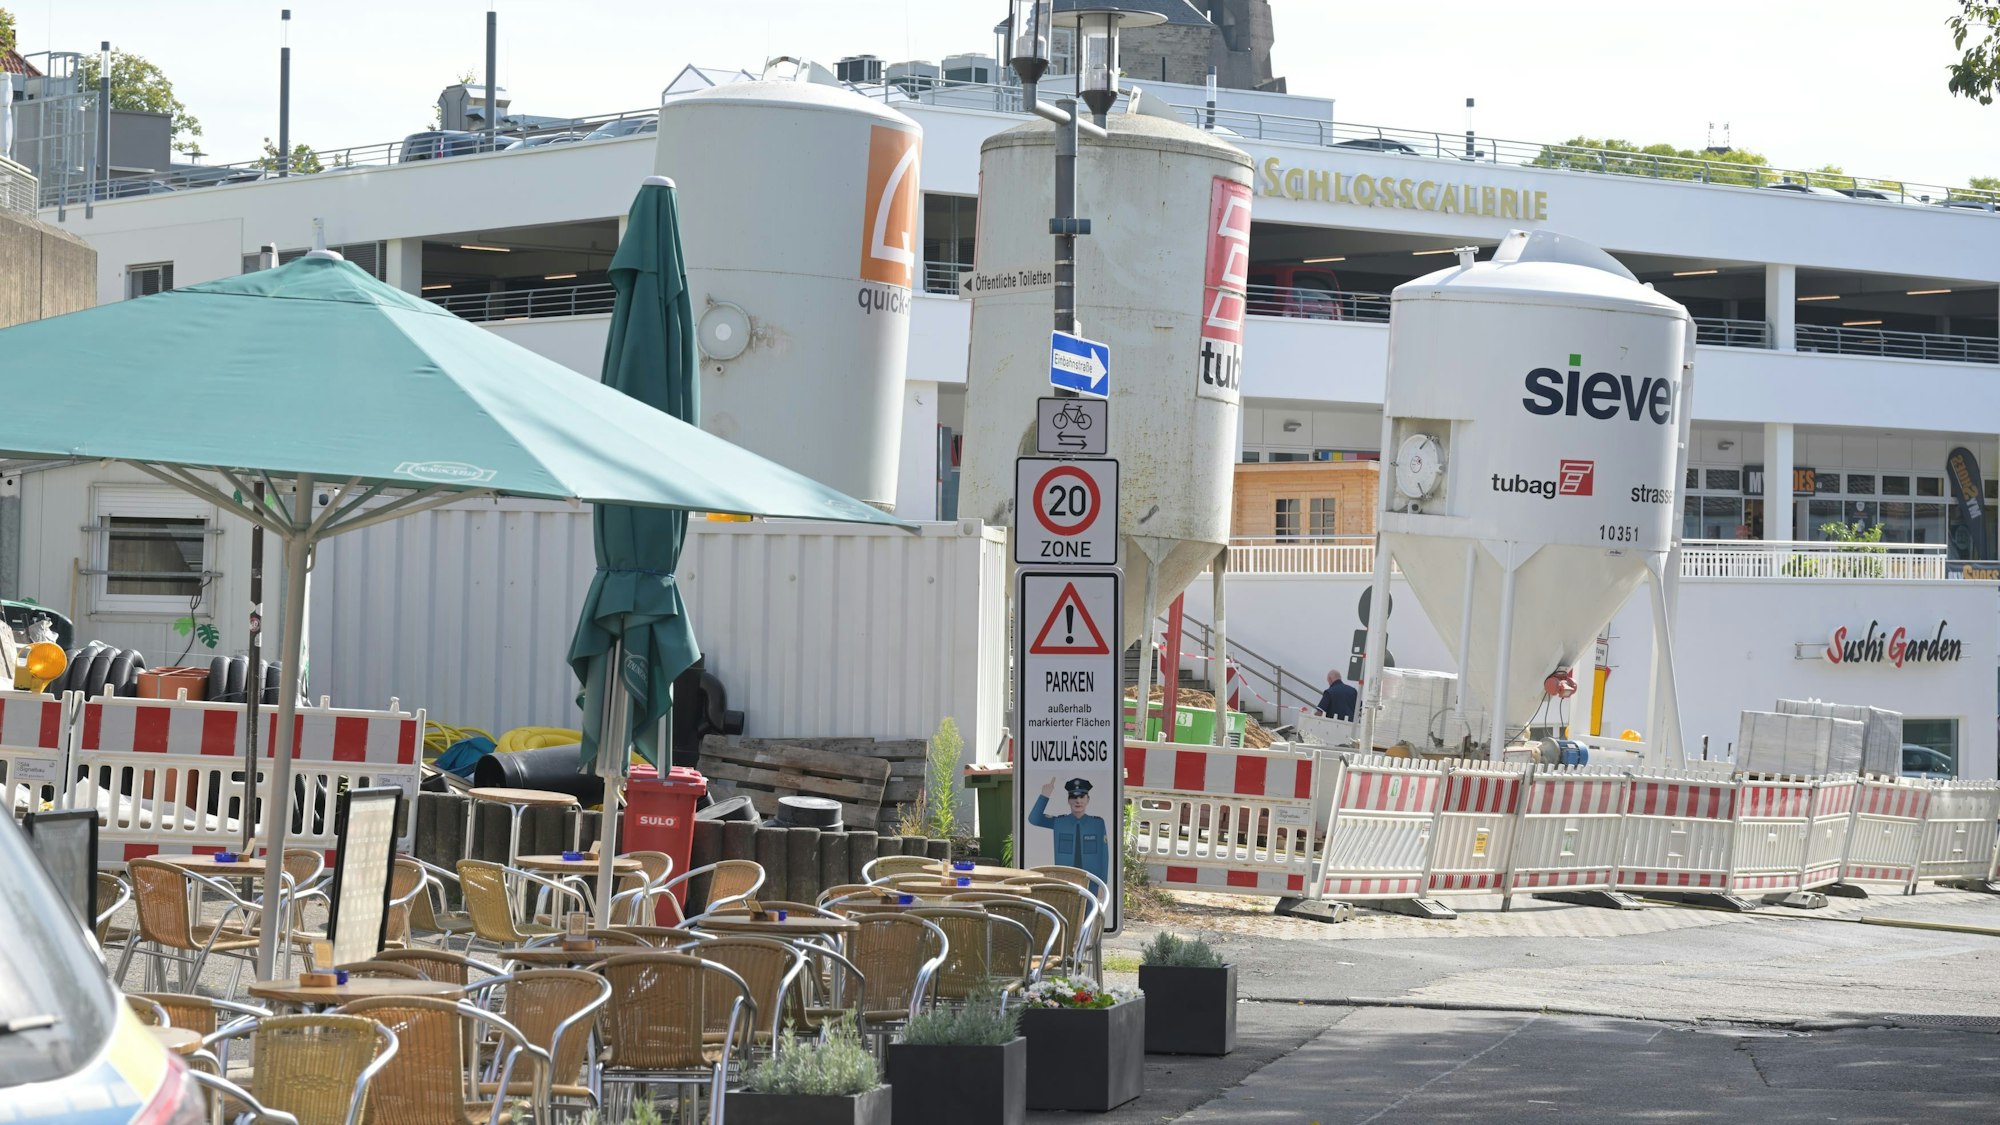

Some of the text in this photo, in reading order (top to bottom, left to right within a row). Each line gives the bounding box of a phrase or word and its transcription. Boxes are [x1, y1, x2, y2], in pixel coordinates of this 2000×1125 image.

[1263, 156, 1548, 221] SCHLOSSGALERIE
[976, 270, 1052, 291] Öffentliche Toiletten
[1054, 353, 1093, 374] Einbahnstraße
[1492, 473, 1557, 499] tubag
[1048, 484, 1086, 517] 20
[1600, 525, 1639, 542] 10351
[1040, 540, 1092, 558] ZONE
[1826, 619, 1962, 669] Sushi Garden
[1045, 671, 1094, 692] PARKEN
[1047, 703, 1092, 713] außerhalb
[1028, 717, 1111, 727] markierter Flächen
[1031, 735, 1108, 762] UNZULÄSSIG
[640, 815, 675, 827] SULO
